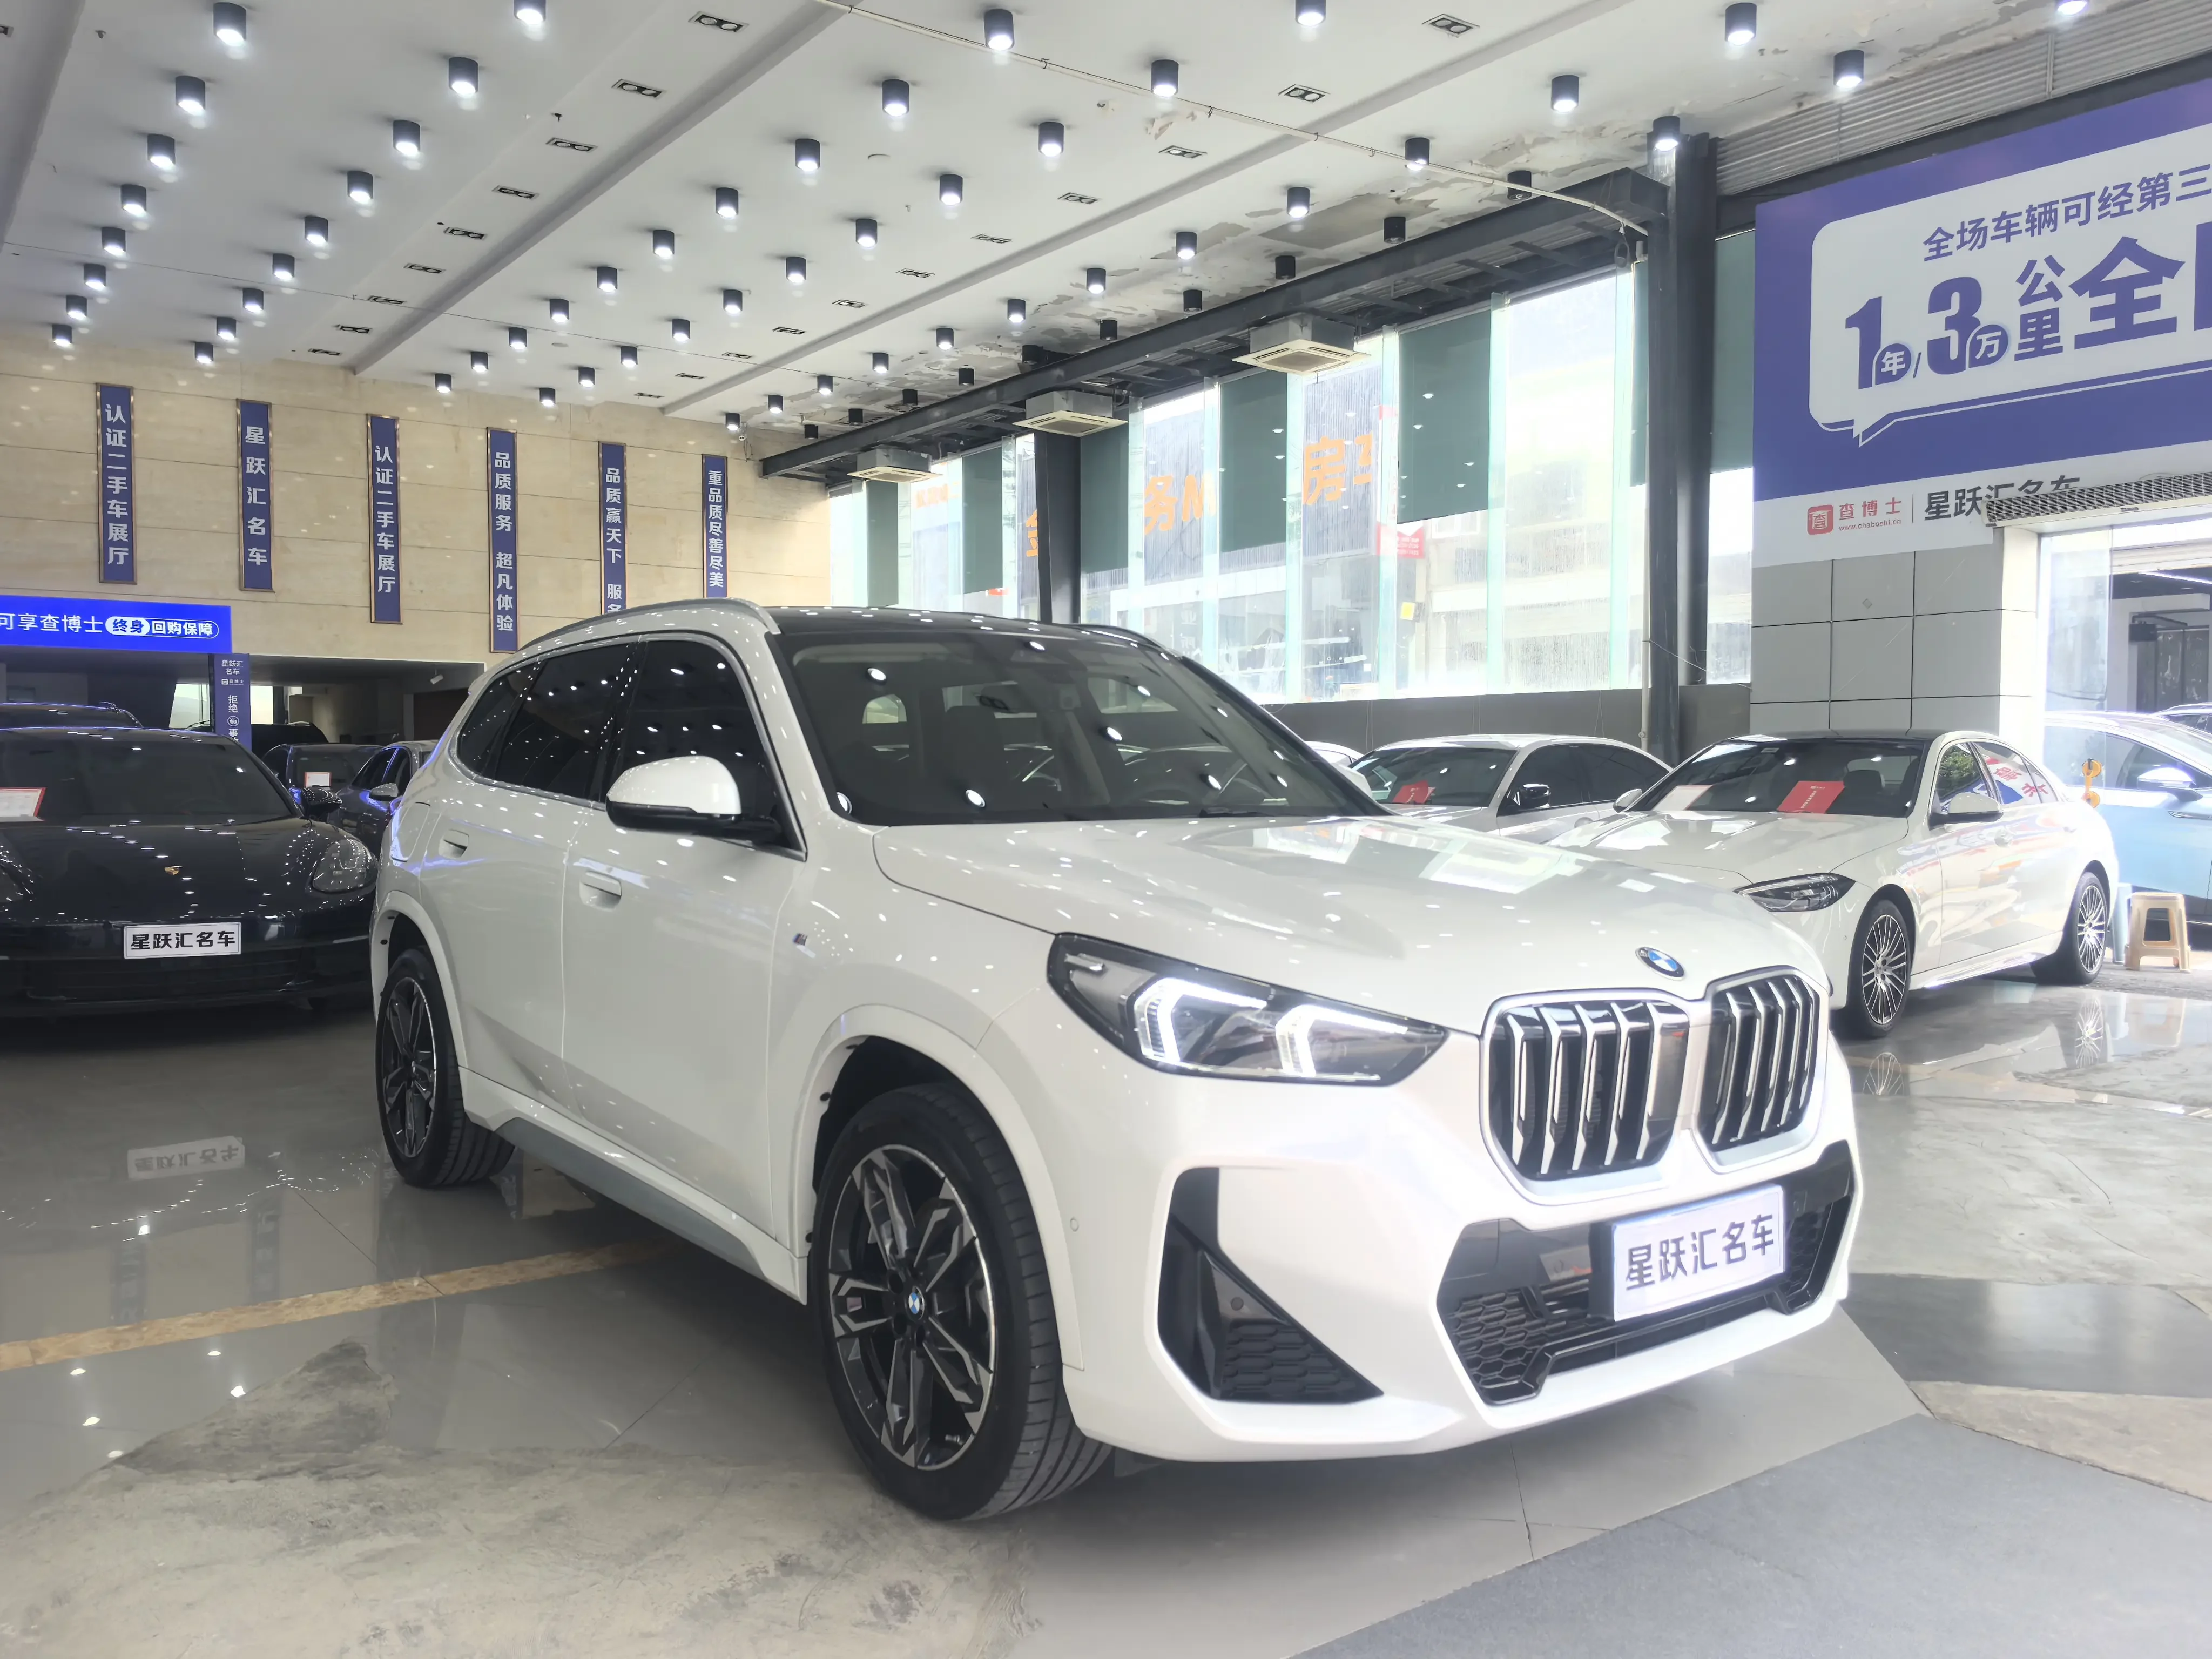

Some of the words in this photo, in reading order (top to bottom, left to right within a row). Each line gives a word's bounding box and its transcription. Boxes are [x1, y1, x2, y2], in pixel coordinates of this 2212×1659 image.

[1924, 163, 2212, 261] 全场车辆可经第三
[105, 404, 129, 565] 认证二手车展厅
[245, 426, 268, 565] 星跃汇名车
[375, 445, 395, 593] 认证二手车展厅
[495, 452, 512, 531] 品质服务
[605, 468, 622, 564] 品质赢天下
[1839, 497, 1901, 521] 查博士
[708, 470, 724, 588] 重品质尽善尽美
[1839, 519, 1901, 531] www.chaboshi.cn
[496, 552, 514, 631] 超凡体验
[228, 695, 238, 713] 拒绝
[130, 929, 236, 950] 星跃汇名车
[1626, 1213, 1775, 1291] 星跃汇名车
